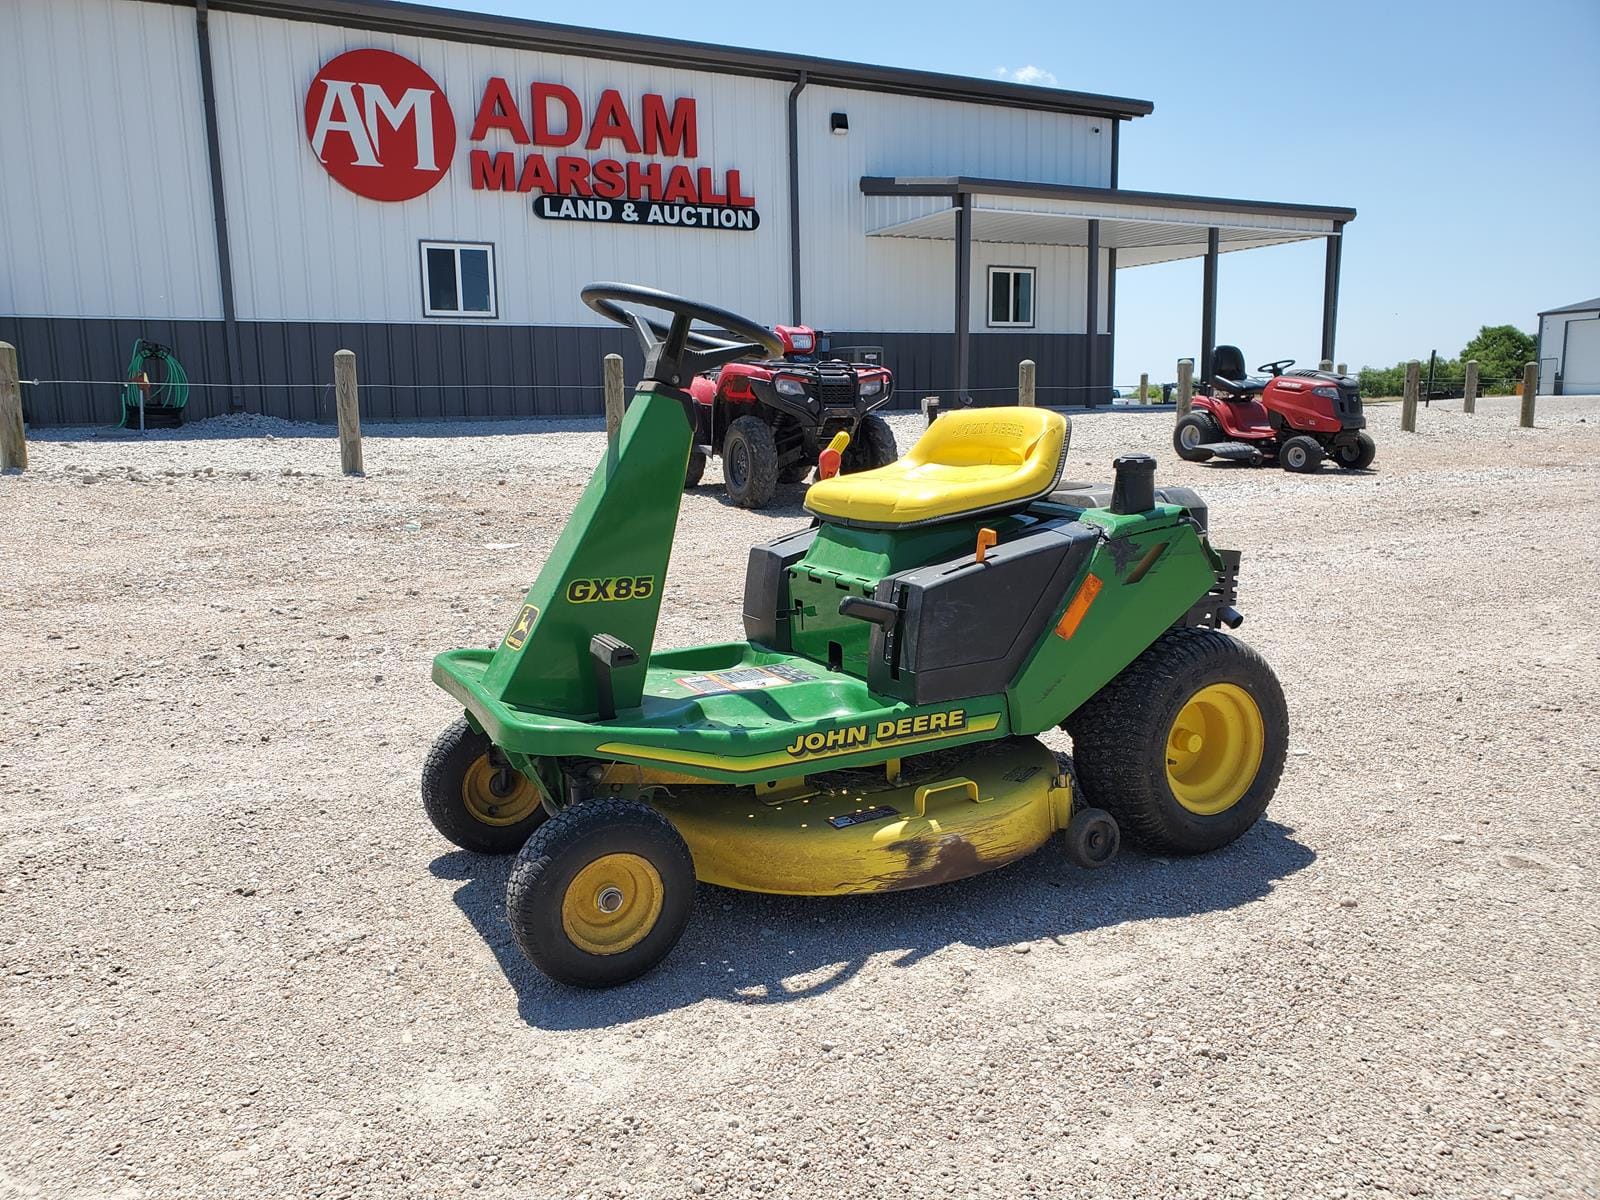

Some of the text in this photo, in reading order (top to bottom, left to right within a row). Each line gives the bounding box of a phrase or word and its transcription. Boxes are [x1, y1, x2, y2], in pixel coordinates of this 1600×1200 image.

[311, 79, 440, 171] AM
[470, 77, 698, 158] ADAM
[470, 150, 755, 206] MARSHALL
[543, 197, 754, 228] LAND & AUCTION
[568, 576, 654, 601] GX85
[787, 710, 966, 755] JOHN DEERE
